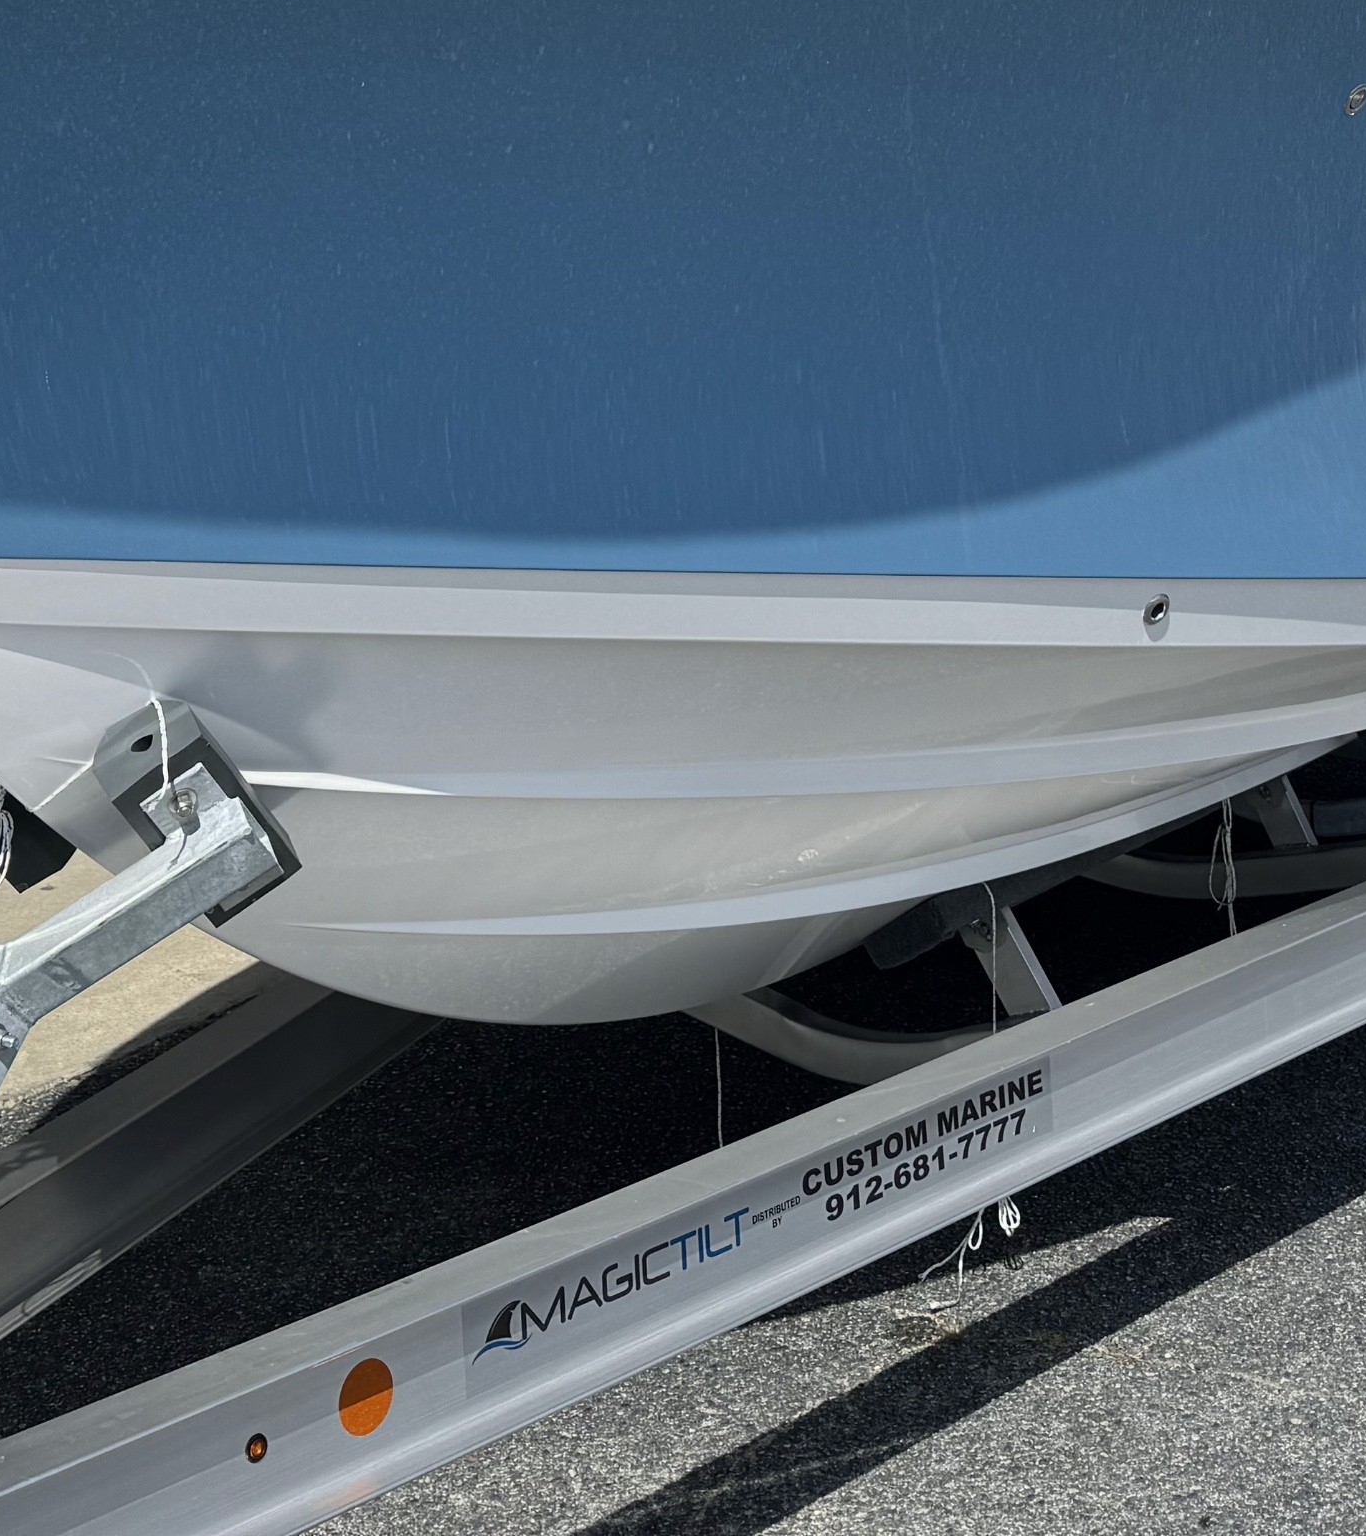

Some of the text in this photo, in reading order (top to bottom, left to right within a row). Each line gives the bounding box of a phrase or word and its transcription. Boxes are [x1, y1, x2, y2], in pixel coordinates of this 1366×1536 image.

[802, 1070, 1044, 1196] CUSTOM MARINE
[825, 1108, 1028, 1222] 912-681-7777
[751, 1195, 801, 1225] DISTRIBUTED
[771, 1215, 783, 1229] BY
[519, 1207, 750, 1341] MAGICTILT
